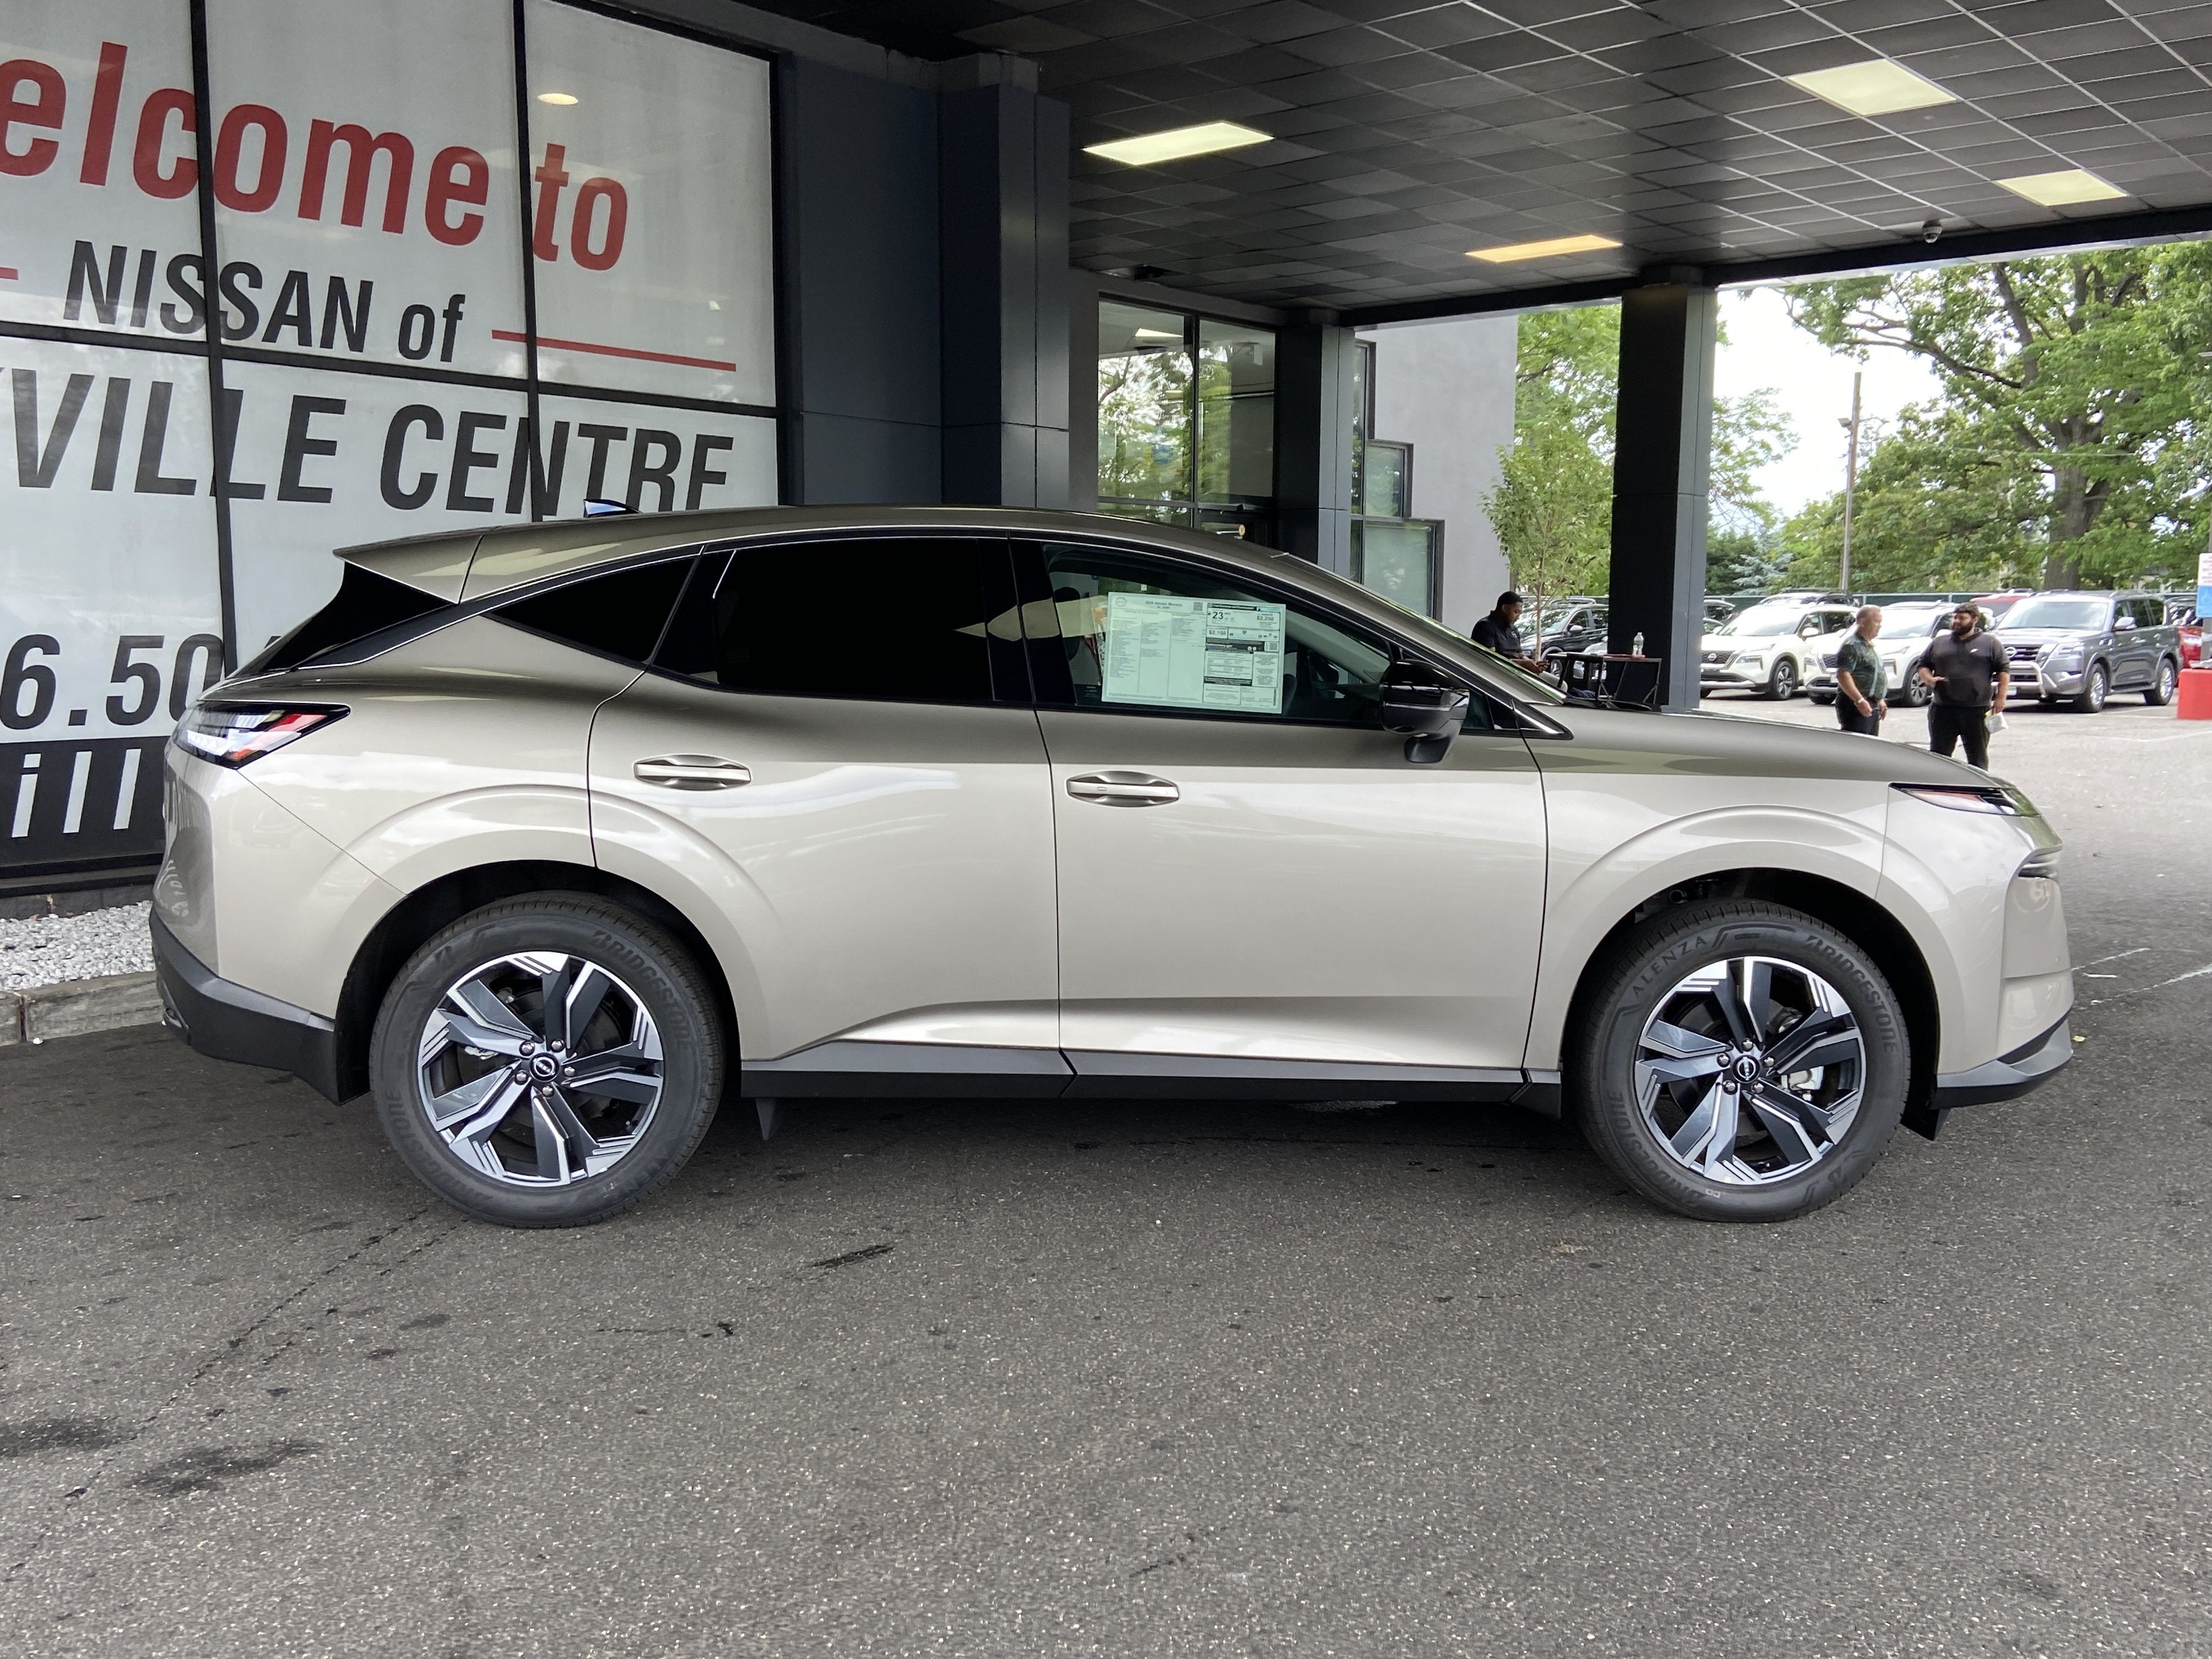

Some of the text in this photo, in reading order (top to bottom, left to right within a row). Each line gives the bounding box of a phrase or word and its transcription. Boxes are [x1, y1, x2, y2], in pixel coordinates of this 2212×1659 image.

[532, 143, 628, 271] to
[64, 240, 466, 362] NISSAN of
[0, 368, 347, 504] VILLE
[0, 634, 281, 730] 6.50
[1632, 935, 1707, 997] ALENZA
